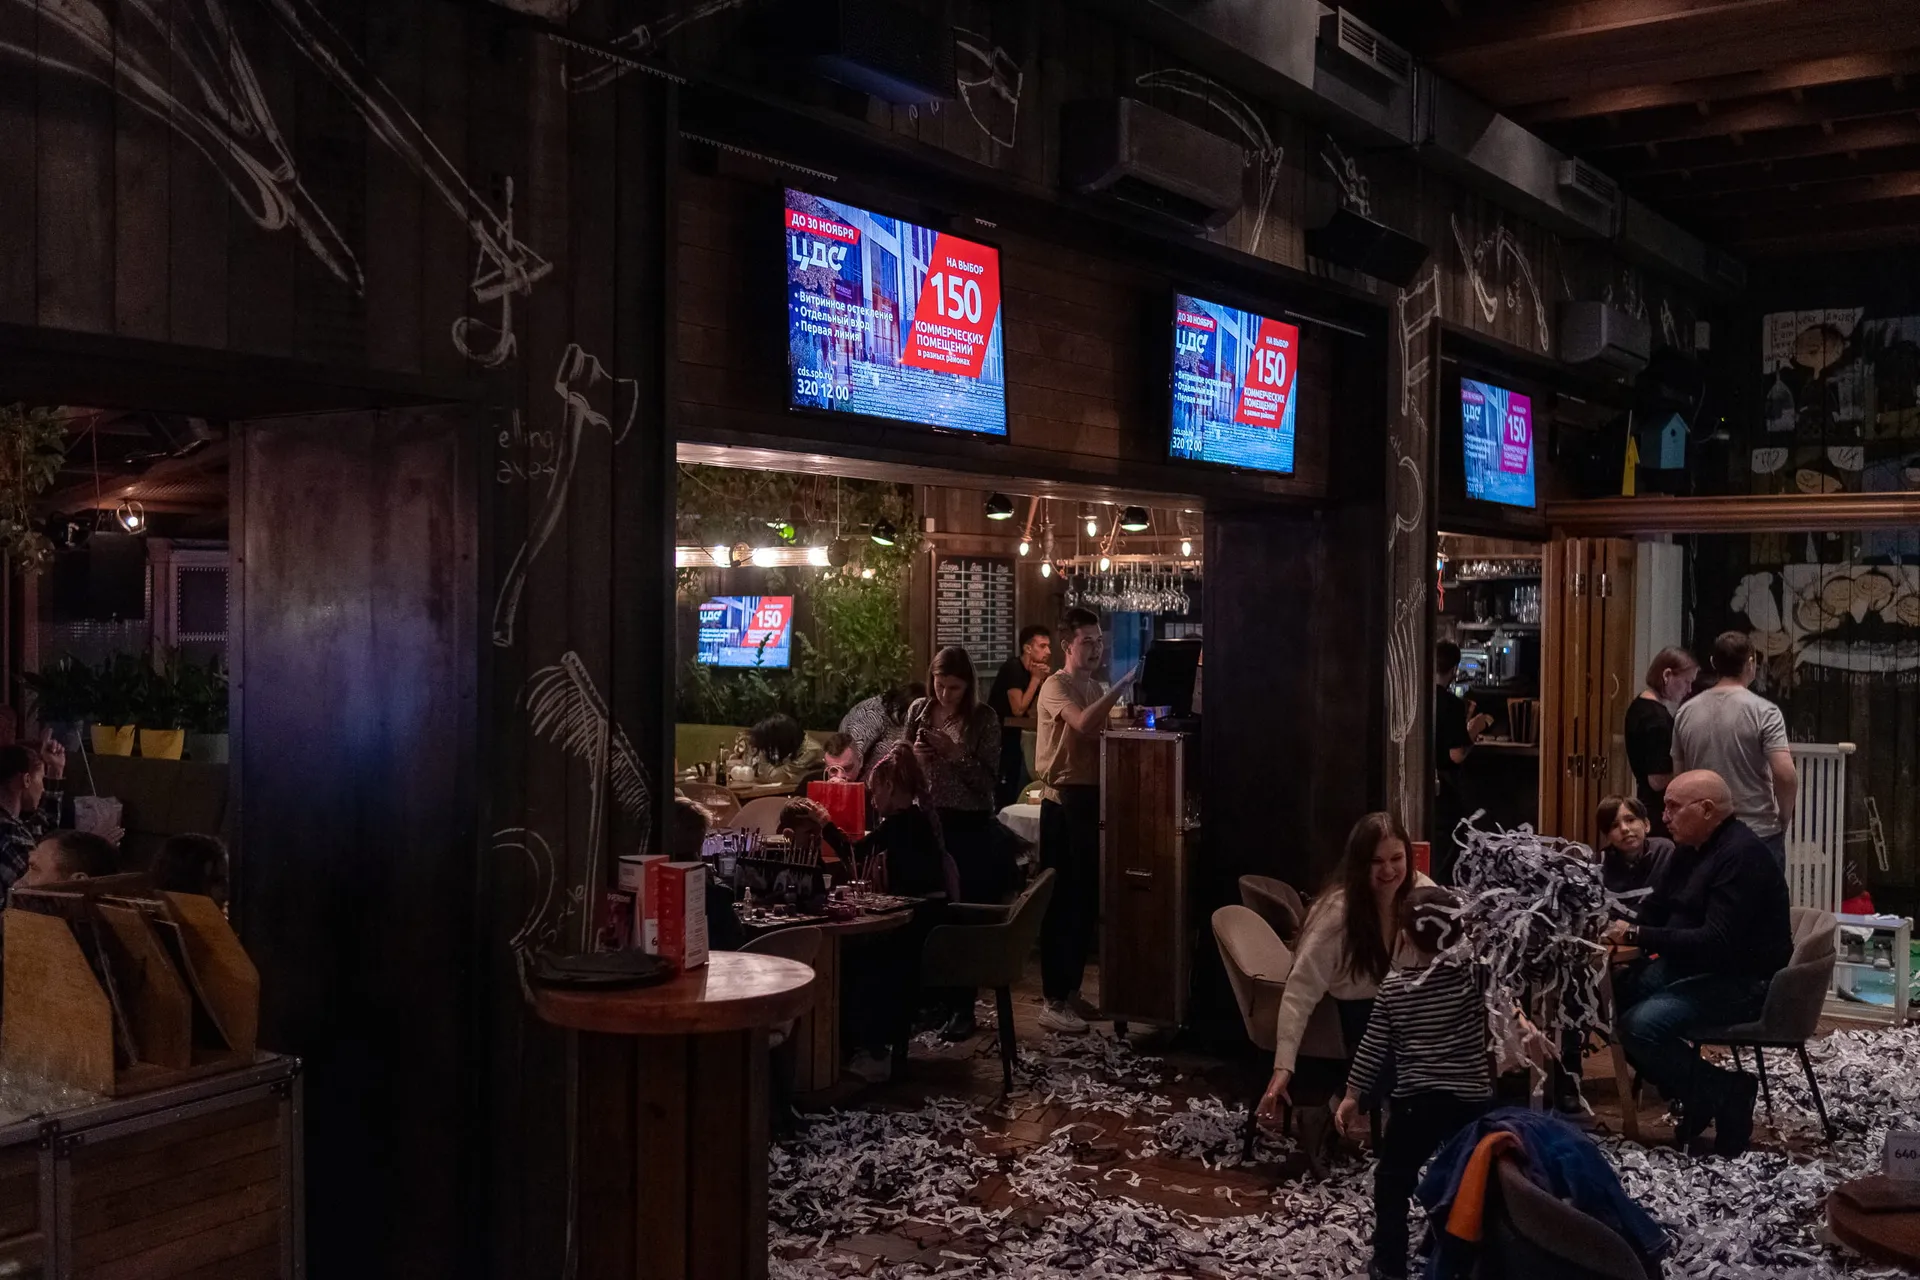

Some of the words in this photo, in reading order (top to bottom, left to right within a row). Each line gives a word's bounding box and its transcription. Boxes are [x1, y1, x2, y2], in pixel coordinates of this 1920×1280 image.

[792, 214, 806, 227] ДО
[808, 217, 818, 229] 30
[820, 220, 854, 240] НОЯБРЯ
[792, 236, 847, 271] ЦДС
[947, 257, 957, 267] НА
[959, 260, 984, 275] ВЫБОР
[800, 292, 845, 311] Витринное
[847, 302, 893, 322] остекление
[931, 272, 982, 323] 150
[801, 306, 848, 325] Отдельный
[850, 317, 870, 332] вход
[1177, 312, 1185, 322] ДО
[1186, 315, 1192, 324] 30
[1193, 316, 1214, 328] НОЯБРЯ
[801, 321, 832, 337] Первая
[834, 329, 859, 342] линия
[916, 320, 984, 345] КОММЕРЧЕСКИХ
[1266, 336, 1272, 344] НА
[1274, 338, 1289, 348] ВЫБОР
[917, 334, 973, 355] ПОМЕЩЕНИЙ
[923, 350, 944, 363] разных
[946, 352, 970, 366] районах
[1256, 348, 1286, 387] 150
[798, 366, 832, 381] cds.spb.ru
[798, 379, 818, 395] 320
[821, 382, 833, 398] 12
[836, 385, 849, 400] 00
[1244, 387, 1285, 403] КОММЕРЧЕСКИХ
[1244, 397, 1277, 412] ПОМЕЩЕНИЙ
[1508, 414, 1526, 443] 150
[1172, 437, 1185, 449] 320
[1186, 439, 1193, 451] 12
[1194, 440, 1202, 451] 00
[757, 610, 782, 628] 150
